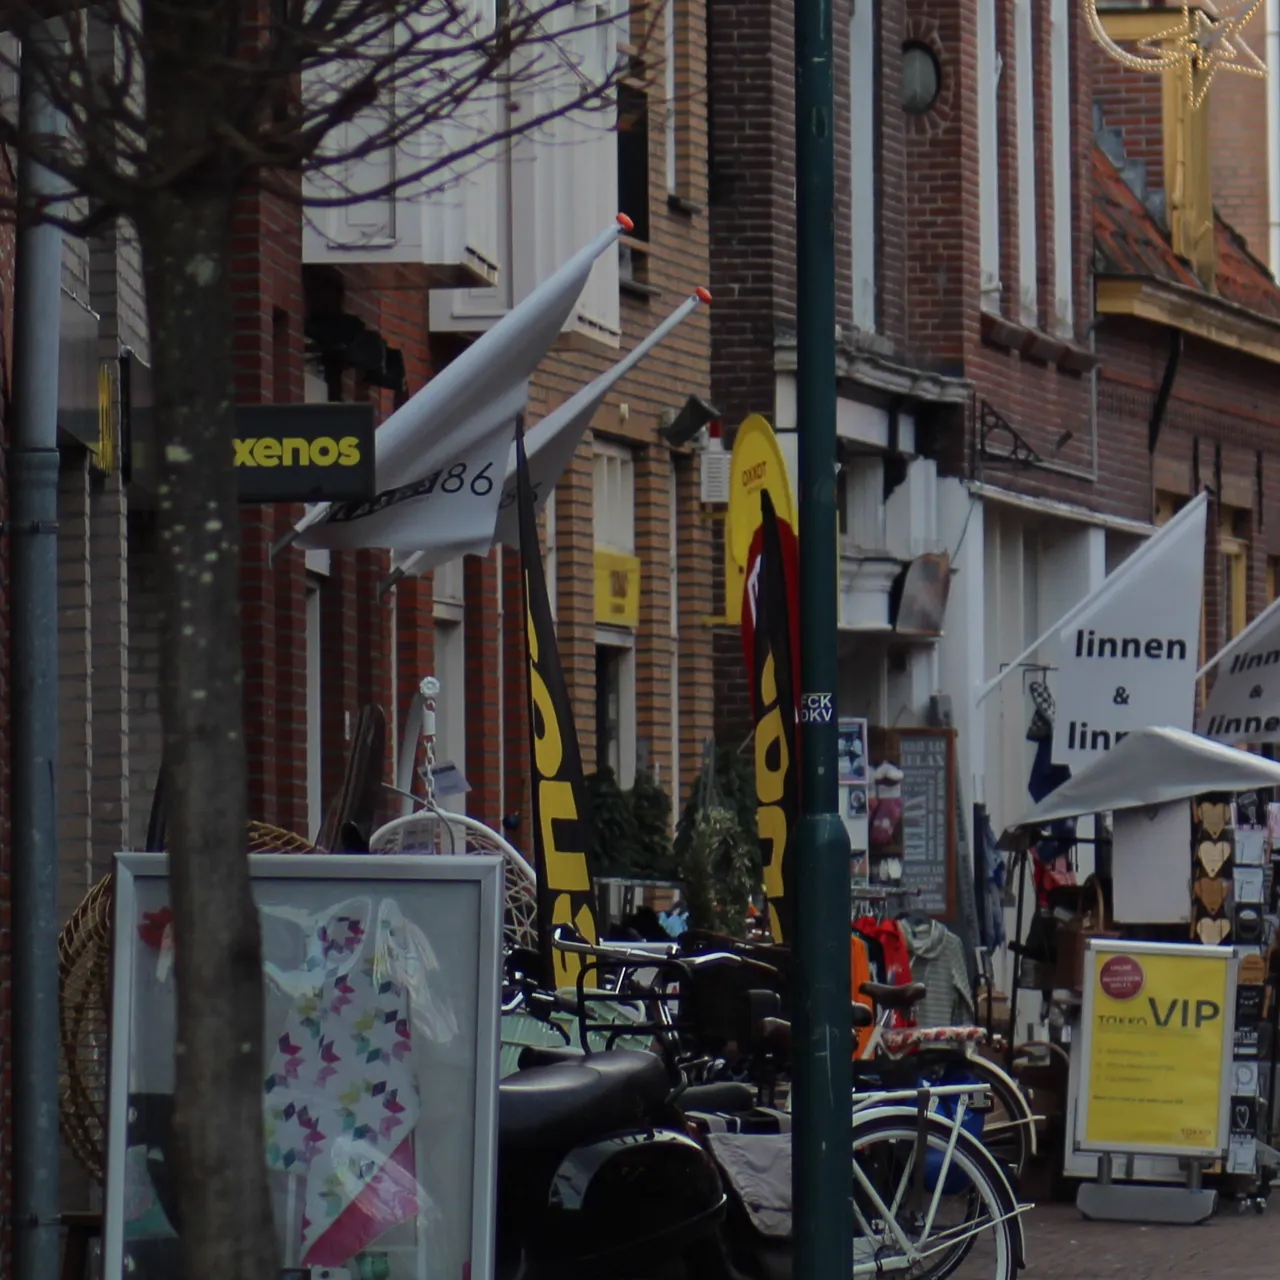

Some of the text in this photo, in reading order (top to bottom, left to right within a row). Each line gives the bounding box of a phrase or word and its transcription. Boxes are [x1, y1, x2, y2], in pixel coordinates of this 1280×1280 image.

[232, 436, 361, 467] xenos
[1075, 629, 1187, 660] linnen
[1113, 686, 1130, 705] &
[1248, 684, 1263, 699] &
[1148, 996, 1221, 1028] VIP
